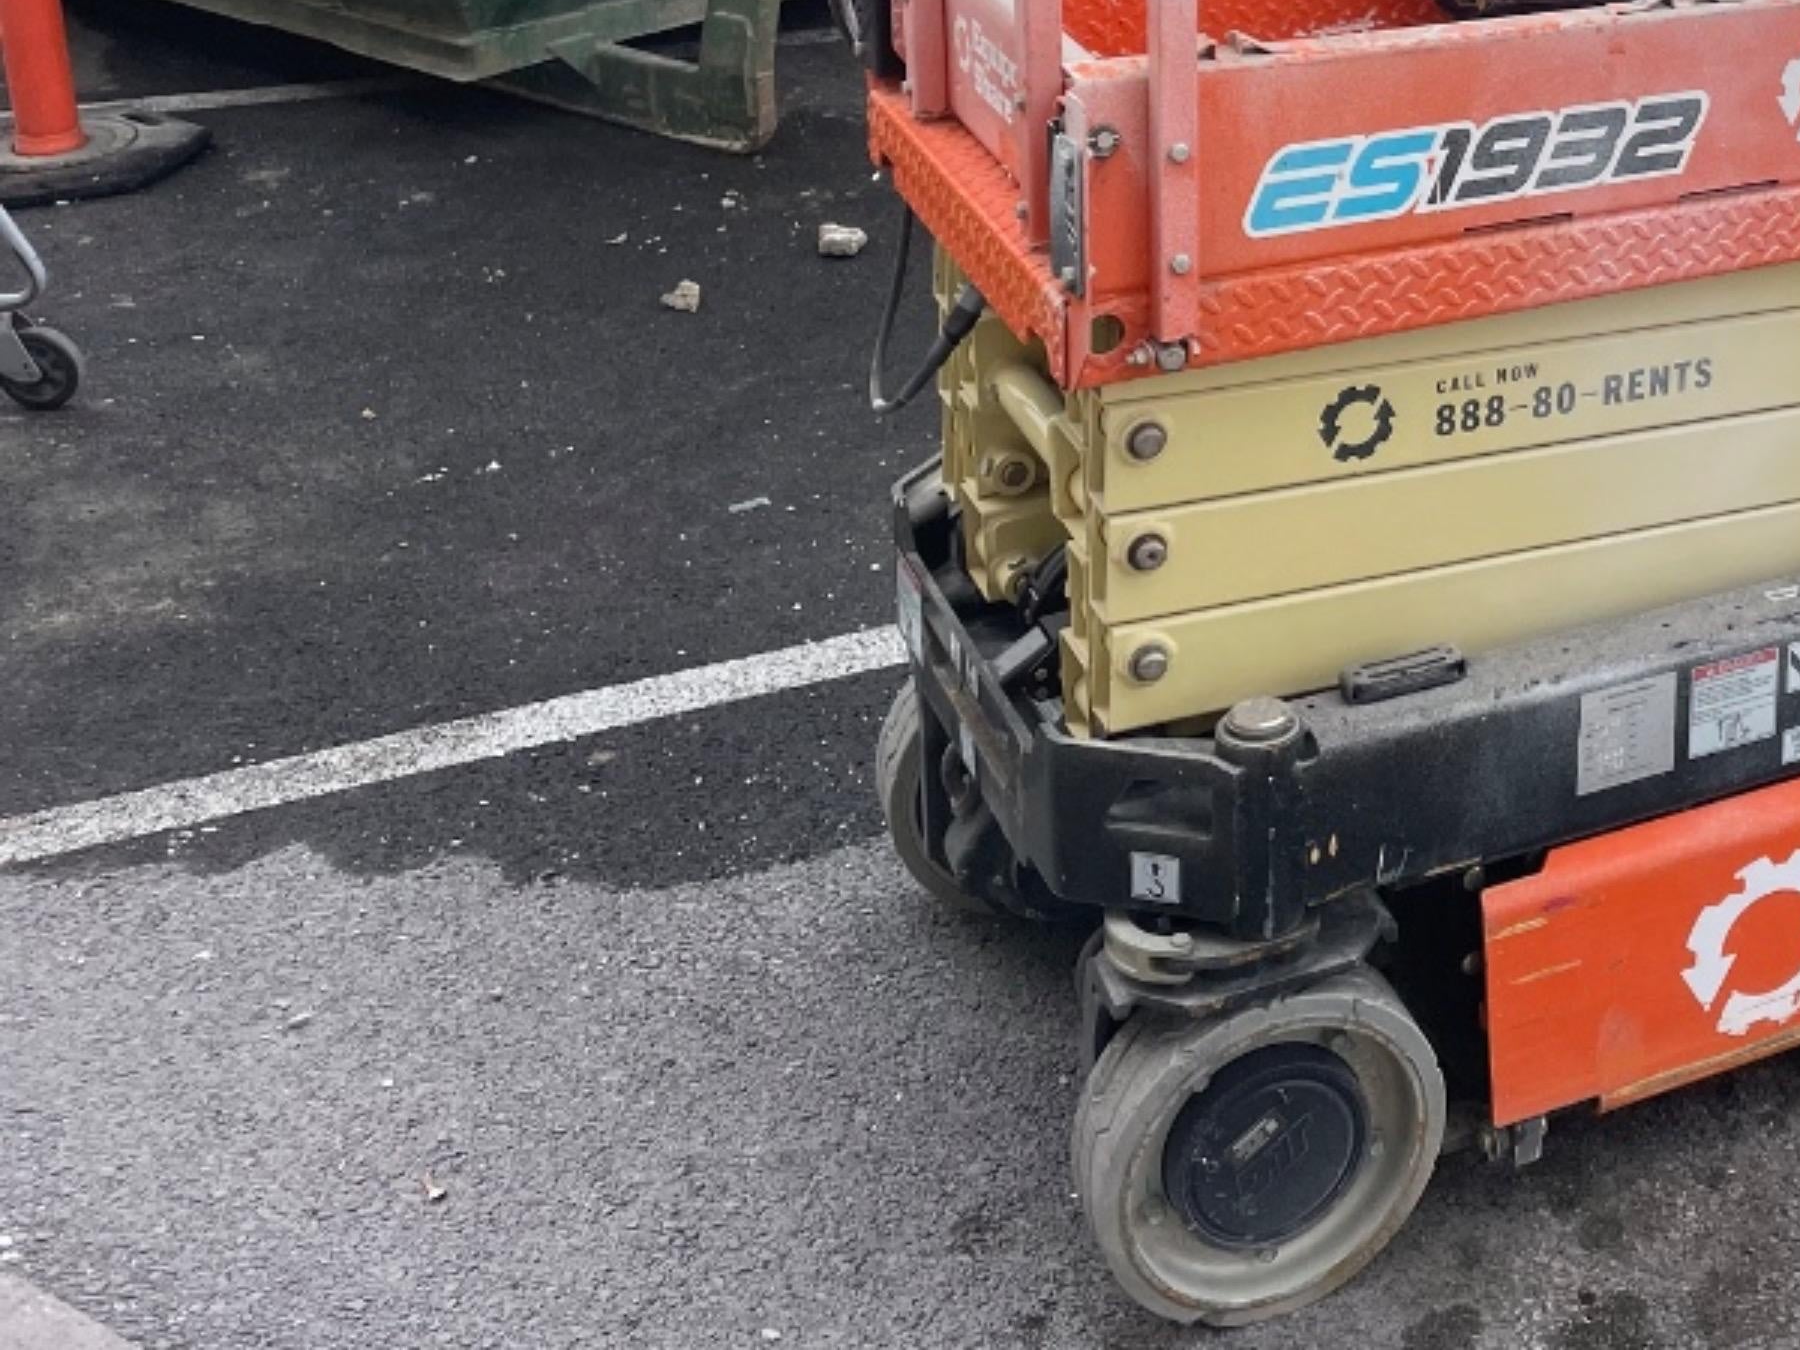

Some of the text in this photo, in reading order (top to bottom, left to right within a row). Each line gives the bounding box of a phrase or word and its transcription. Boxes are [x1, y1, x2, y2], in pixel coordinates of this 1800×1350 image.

[1243, 90, 1709, 239] ES1932
[1434, 357, 1713, 437] 888-80-RENTS
[1435, 362, 1539, 395] CALL NOW
